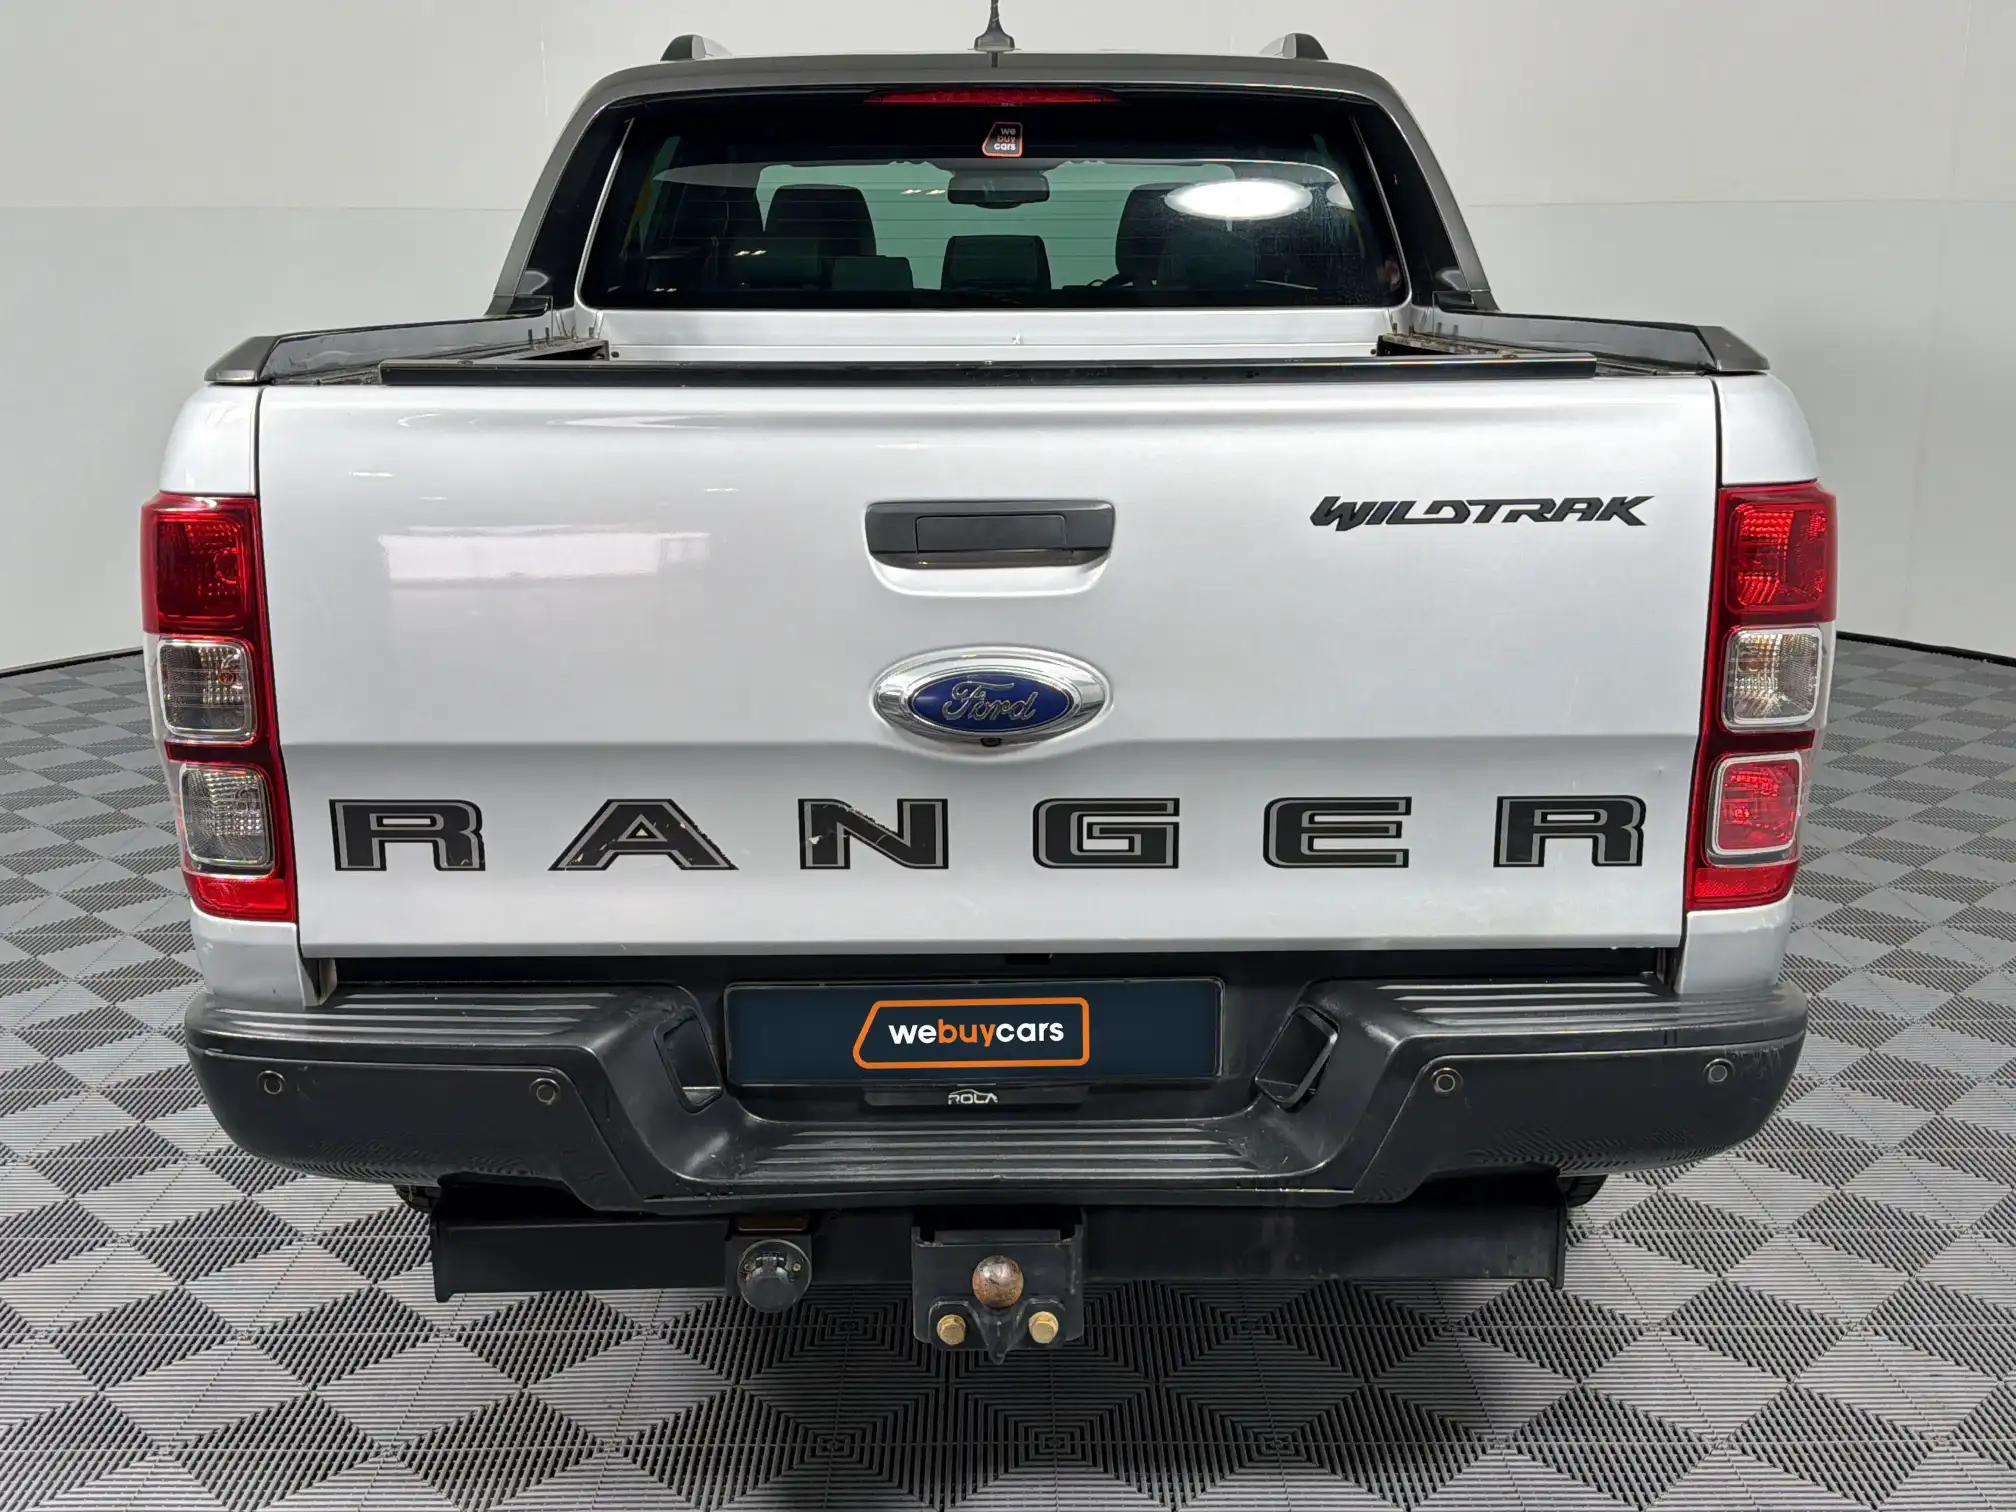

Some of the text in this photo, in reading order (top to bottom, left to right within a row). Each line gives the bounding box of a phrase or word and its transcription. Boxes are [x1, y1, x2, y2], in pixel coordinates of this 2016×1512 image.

[994, 143, 1016, 151] cars
[997, 134, 1016, 144] buy
[1310, 496, 1655, 531] WILDTRAK
[942, 680, 1039, 721] Ford
[329, 796, 1645, 871] RANGER
[888, 1019, 1064, 1047] webuycars
[948, 1092, 998, 1105] ROLA
